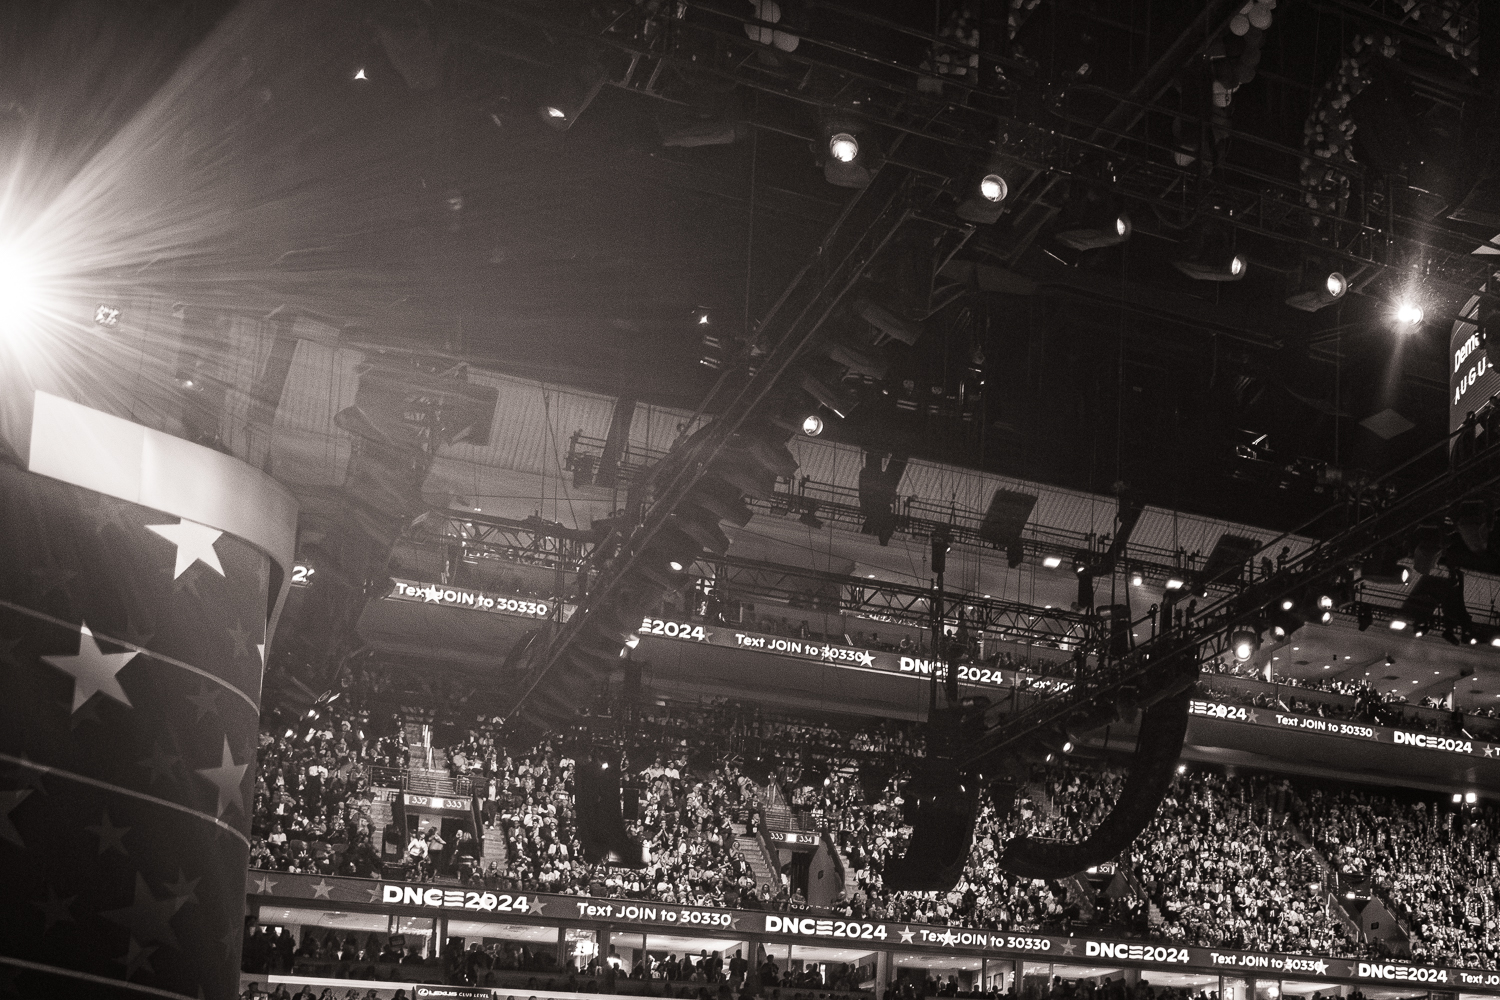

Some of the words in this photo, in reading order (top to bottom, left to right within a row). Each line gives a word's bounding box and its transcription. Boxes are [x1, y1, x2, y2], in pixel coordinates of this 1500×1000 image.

[736, 634, 765, 647] Text
[768, 640, 801, 653] JOIN
[805, 645, 818, 655] to
[820, 644, 864, 662] 30330
[1276, 715, 1298, 726] Text
[1300, 719, 1325, 730] JOIN
[1328, 723, 1338, 732] to
[1341, 725, 1372, 737] 30330
[577, 903, 612, 916] Text
[616, 906, 656, 920] JOIN
[661, 910, 676, 921] to
[680, 911, 731, 926] 30330
[1460, 973, 1483, 983] Text
